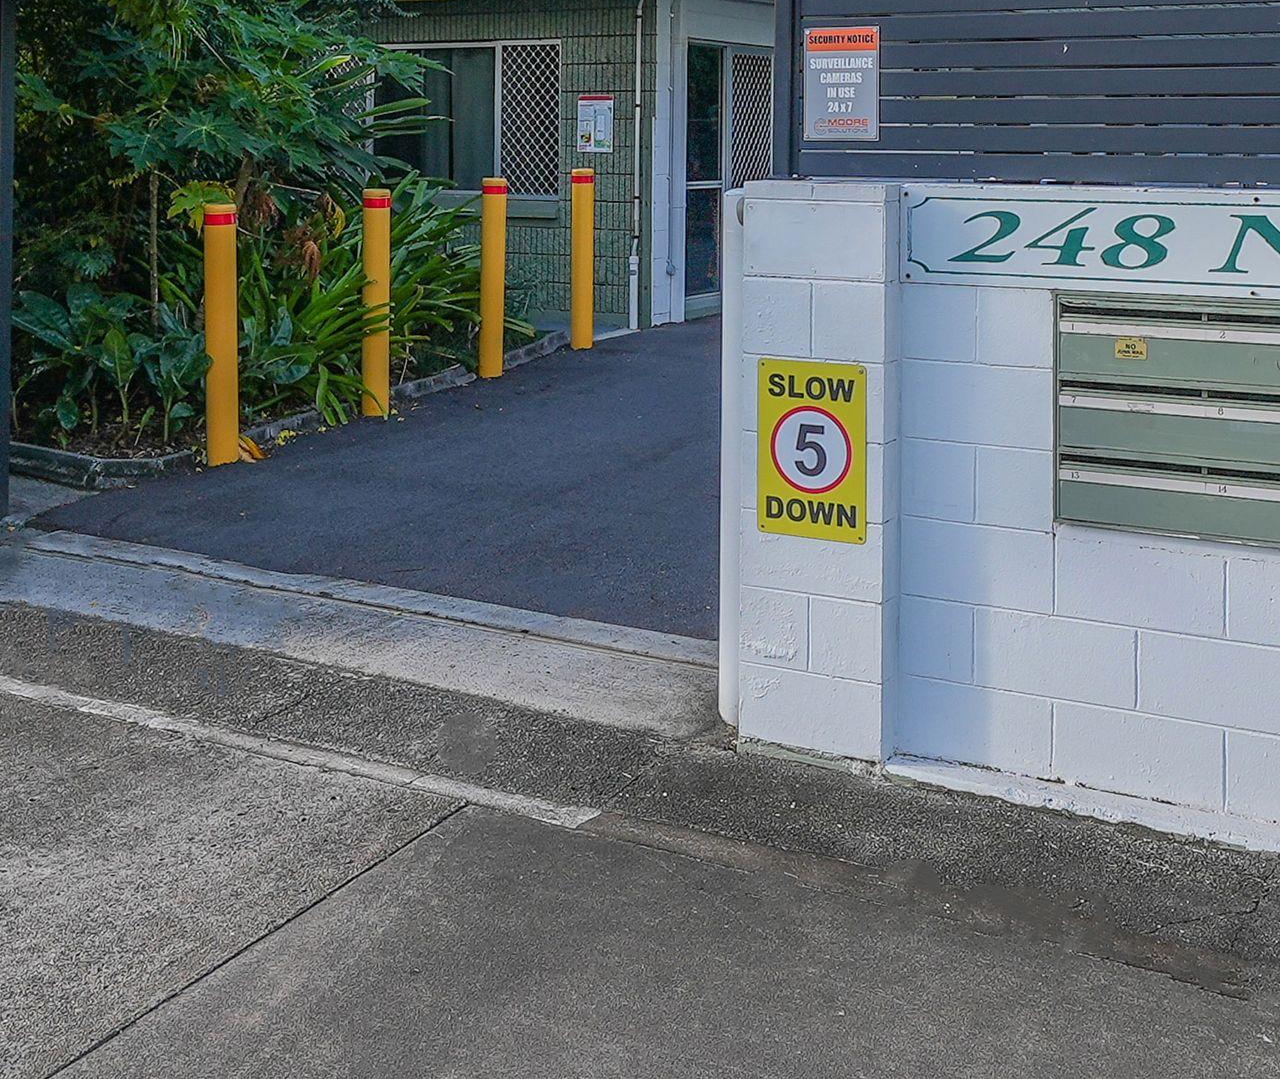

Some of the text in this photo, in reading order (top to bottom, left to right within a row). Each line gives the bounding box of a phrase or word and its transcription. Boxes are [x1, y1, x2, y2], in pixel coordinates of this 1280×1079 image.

[808, 34, 874, 44] SECURITY NOTICE
[810, 57, 874, 69] SURVEILLANCE
[820, 72, 863, 84] CAMERAS
[827, 87, 856, 98] IN USE
[827, 118, 868, 126] MOORE
[947, 206, 1176, 270] 248
[1220, 331, 1226, 339] 2
[768, 373, 855, 403] SLOW
[1071, 395, 1077, 405] 7
[1217, 407, 1224, 416] 8
[794, 423, 827, 477] 5
[1070, 471, 1080, 479] 13
[1218, 485, 1227, 494] 14
[765, 495, 857, 529] DOWN
